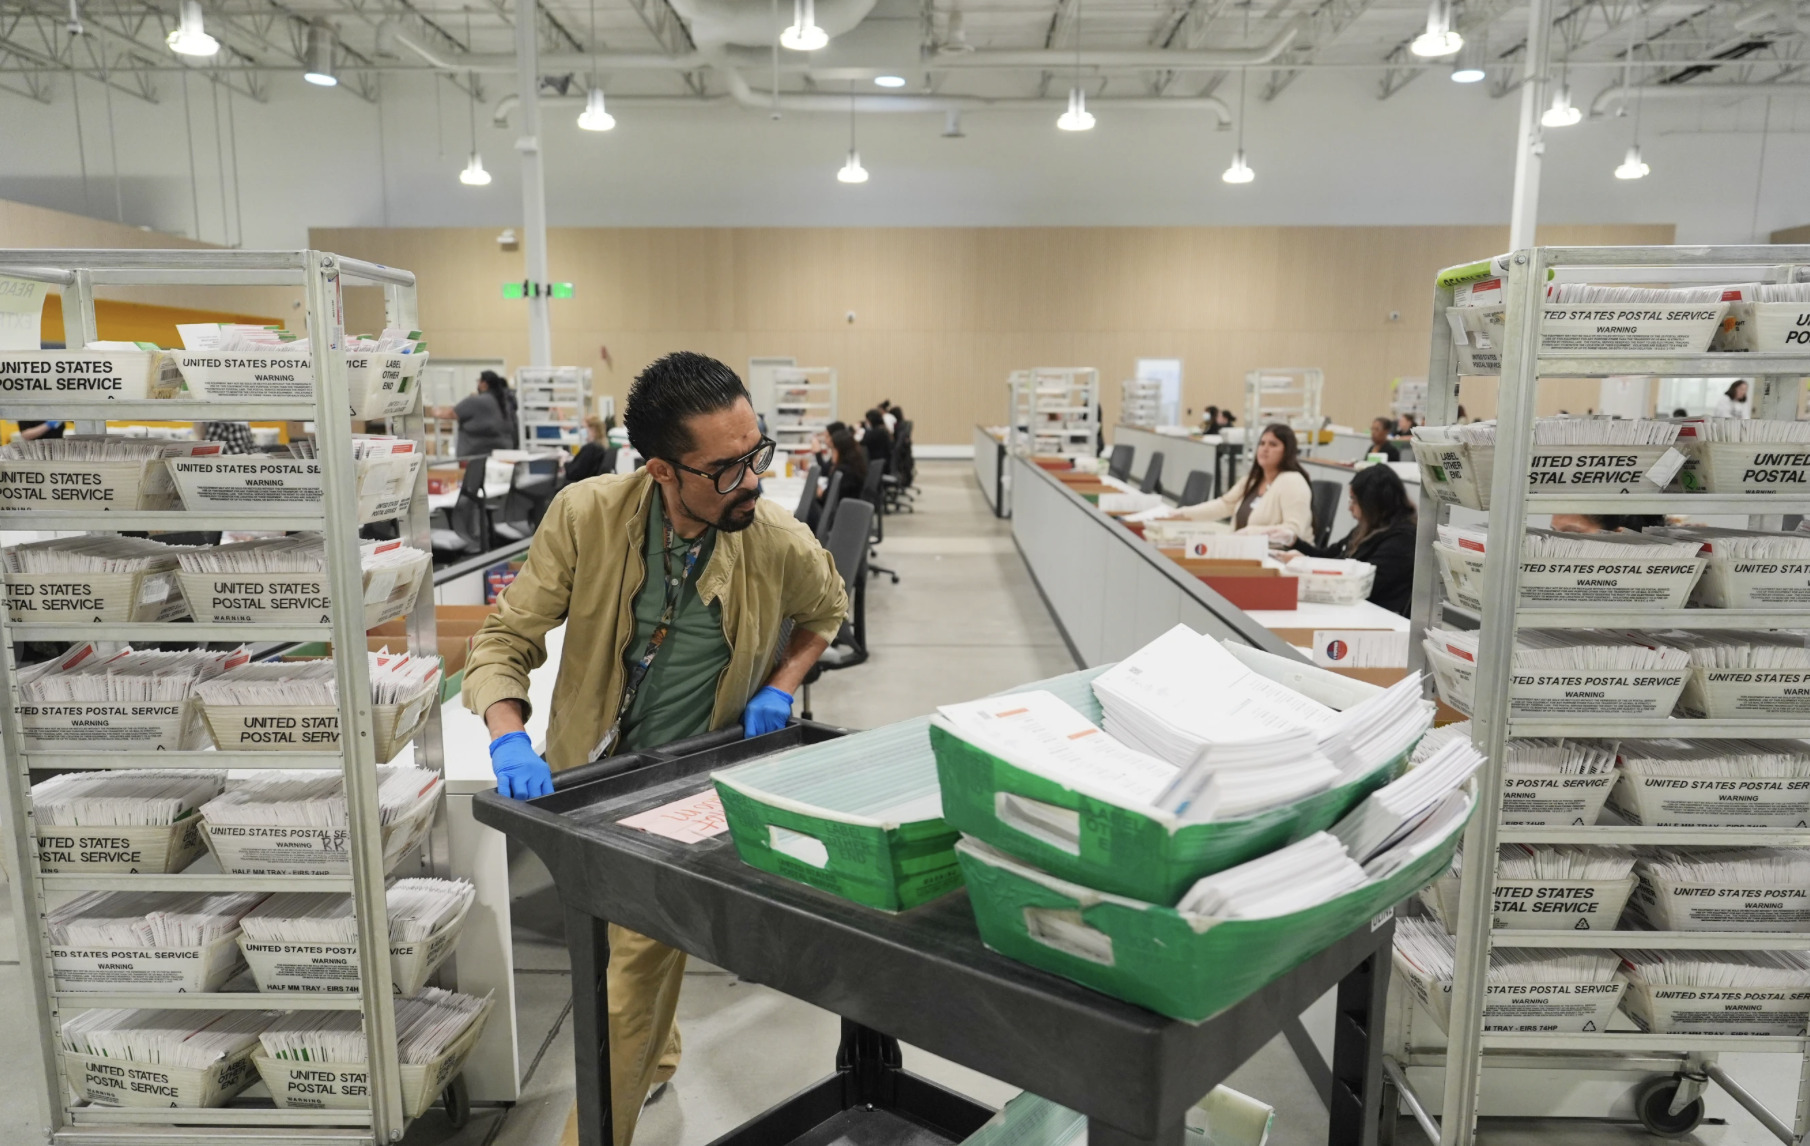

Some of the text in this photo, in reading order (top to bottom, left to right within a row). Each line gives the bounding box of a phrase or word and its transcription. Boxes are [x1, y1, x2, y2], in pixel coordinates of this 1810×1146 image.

[1544, 310, 1717, 321] TED STATES POSTAL SERVICE
[1596, 326, 1637, 334] WARNING
[55, 361, 113, 373] STATES
[183, 359, 310, 368] UNITED STATES POSTA
[386, 360, 401, 368] LABEL
[382, 371, 399, 379] OTHER
[56, 378, 122, 390] SERVICE
[382, 382, 393, 390] END
[1440, 452, 1459, 460] LABEL
[1576, 456, 1638, 467] STATES
[177, 464, 303, 474] UNITED STATES POSTAL
[50, 473, 102, 485] STATES
[1530, 471, 1642, 484] STAL SERVICE
[1743, 470, 1807, 482] POSTAL
[52, 489, 113, 500] SERVICE
[1521, 564, 1695, 574] TED STATES POSTAL SERVICE
[1735, 564, 1777, 573] UNITED
[6, 584, 91, 595] TED STATES
[214, 582, 320, 594] UNITED STATES
[6, 599, 104, 610] STAL SERVICE
[212, 597, 331, 609] POSTAL SERVICE
[1512, 676, 1681, 686] TED STATES POSTAL SERVICE
[1708, 673, 1800, 682] UNITED STATES
[21, 706, 179, 715] TED STATES POSTAL SERVICE
[244, 717, 296, 728] UNITED
[240, 732, 340, 743] POSTAL SERV
[1562, 779, 1609, 787] SERVICE
[1645, 779, 1688, 788] UNITED
[1691, 780, 1736, 790] STATES
[1739, 782, 1784, 790] POSTAL
[210, 827, 330, 838] UNITED STATES POSTAL
[79, 838, 130, 848] STATES
[80, 852, 141, 862] SERVICE
[1536, 888, 1594, 898] STATES
[1674, 888, 1807, 898] UNITED STATES POSTAL
[1494, 901, 1599, 913] STAL SERVICE
[51, 950, 199, 959] TED STATES POSTAL SERVICE
[246, 944, 281, 952] UNITED
[284, 946, 322, 954] STATES
[326, 946, 357, 954] POSTA
[1487, 984, 1619, 994] STATES POSTAL SERVICE
[1655, 991, 1786, 1001] UNITED STATES POSTAL
[220, 1058, 246, 1076] LABEL
[86, 1062, 168, 1084] UNITED STATES
[218, 1065, 246, 1084] OTHER
[290, 1070, 367, 1083] UNITED STAT
[86, 1074, 179, 1098] POSTAL SERVICE
[288, 1082, 337, 1095] POSTAL
[87, 1088, 115, 1098] WARNING
